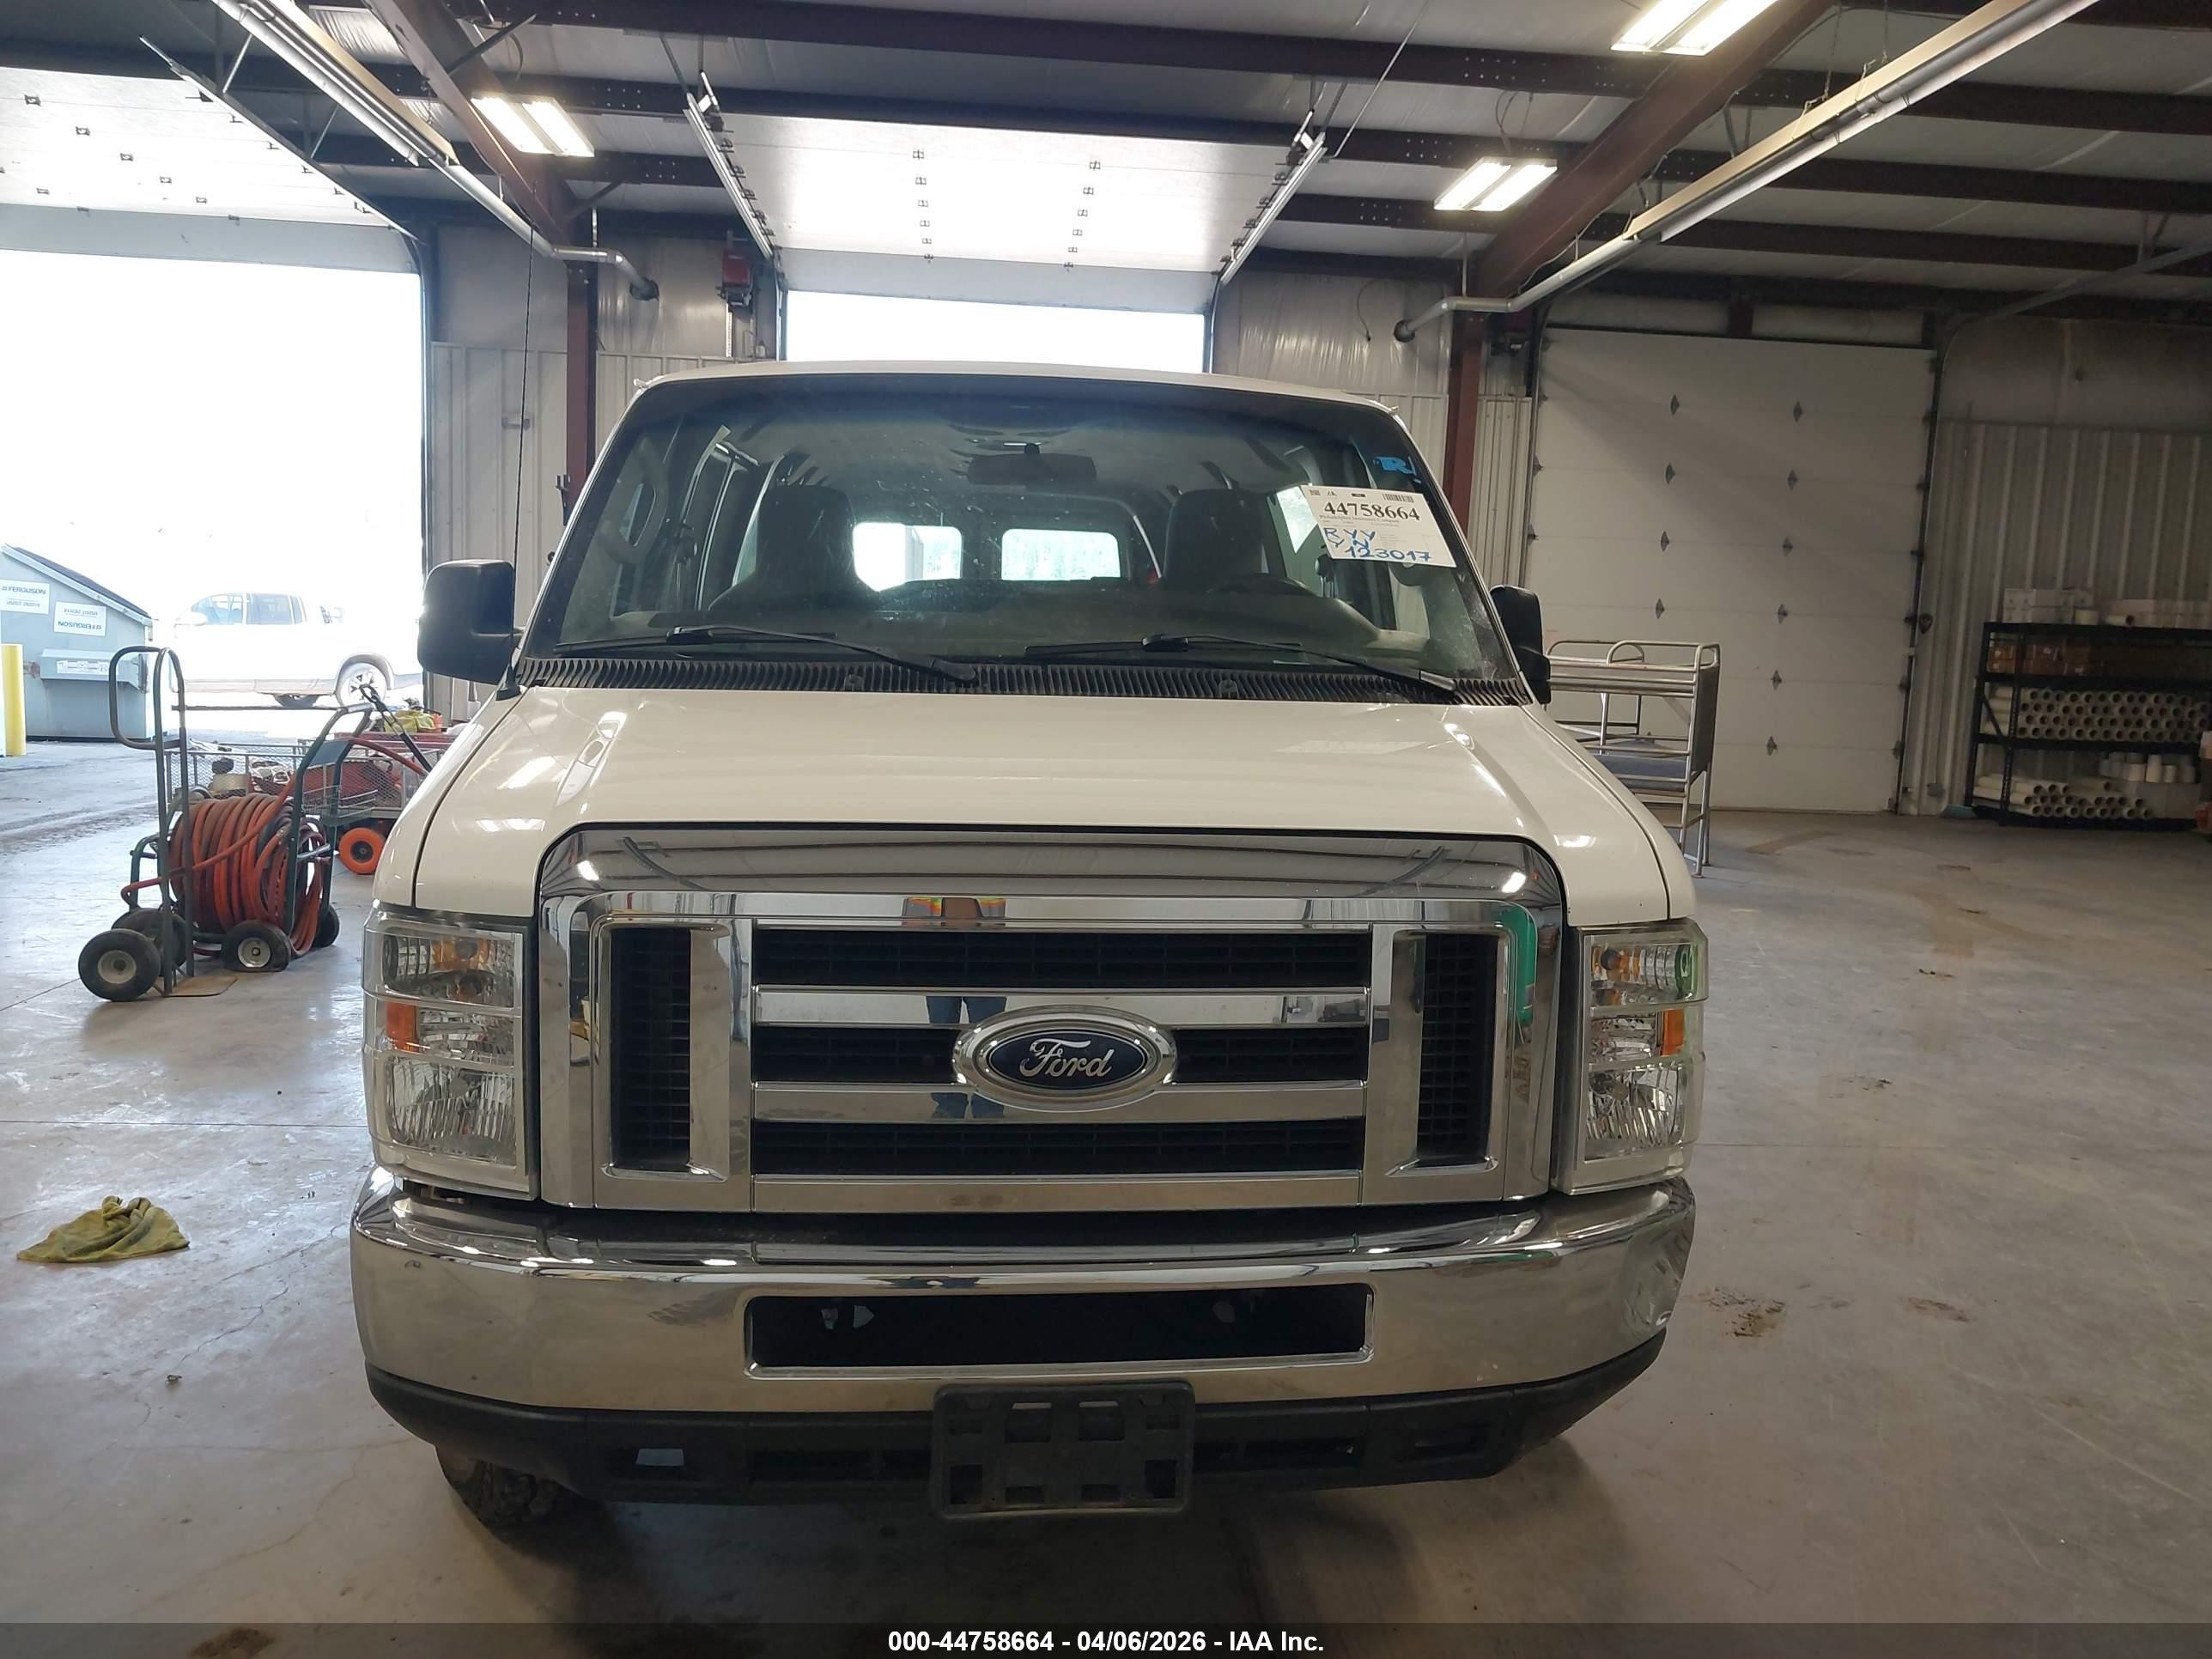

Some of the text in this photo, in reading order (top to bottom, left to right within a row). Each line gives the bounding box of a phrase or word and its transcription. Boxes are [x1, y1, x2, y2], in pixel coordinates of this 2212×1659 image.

[1324, 501, 1420, 520] 44758664
[1345, 546, 1431, 562] 123017
[8, 586, 46, 595] FERGUSON
[58, 620, 96, 629] FERGUSON
[1019, 1037, 1115, 1078] Ford
